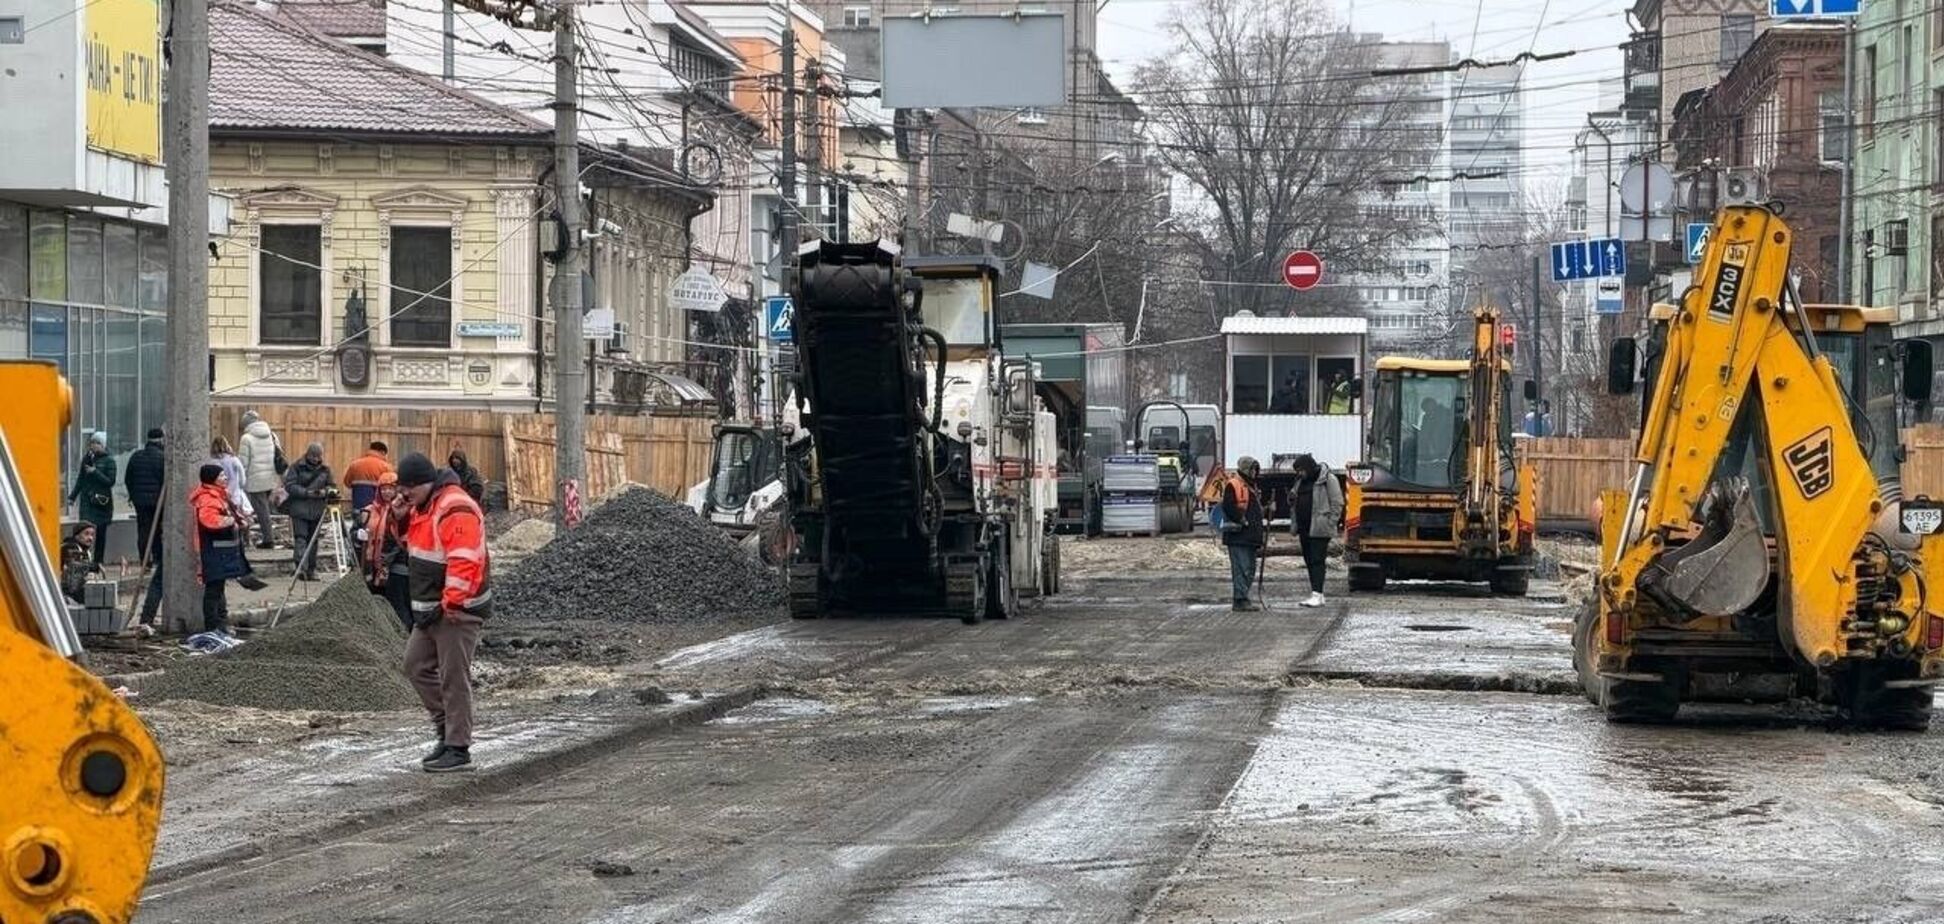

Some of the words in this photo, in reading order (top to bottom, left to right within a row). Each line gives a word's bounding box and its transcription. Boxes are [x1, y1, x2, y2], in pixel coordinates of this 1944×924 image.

[123, 50, 135, 107] ЦЕ
[673, 289, 720, 301] НОТАРІУС
[1714, 267, 1739, 310] 3CX
[1789, 438, 1830, 495] JCB
[1905, 511, 1940, 522] 61395
[1915, 522, 1931, 532] AE
